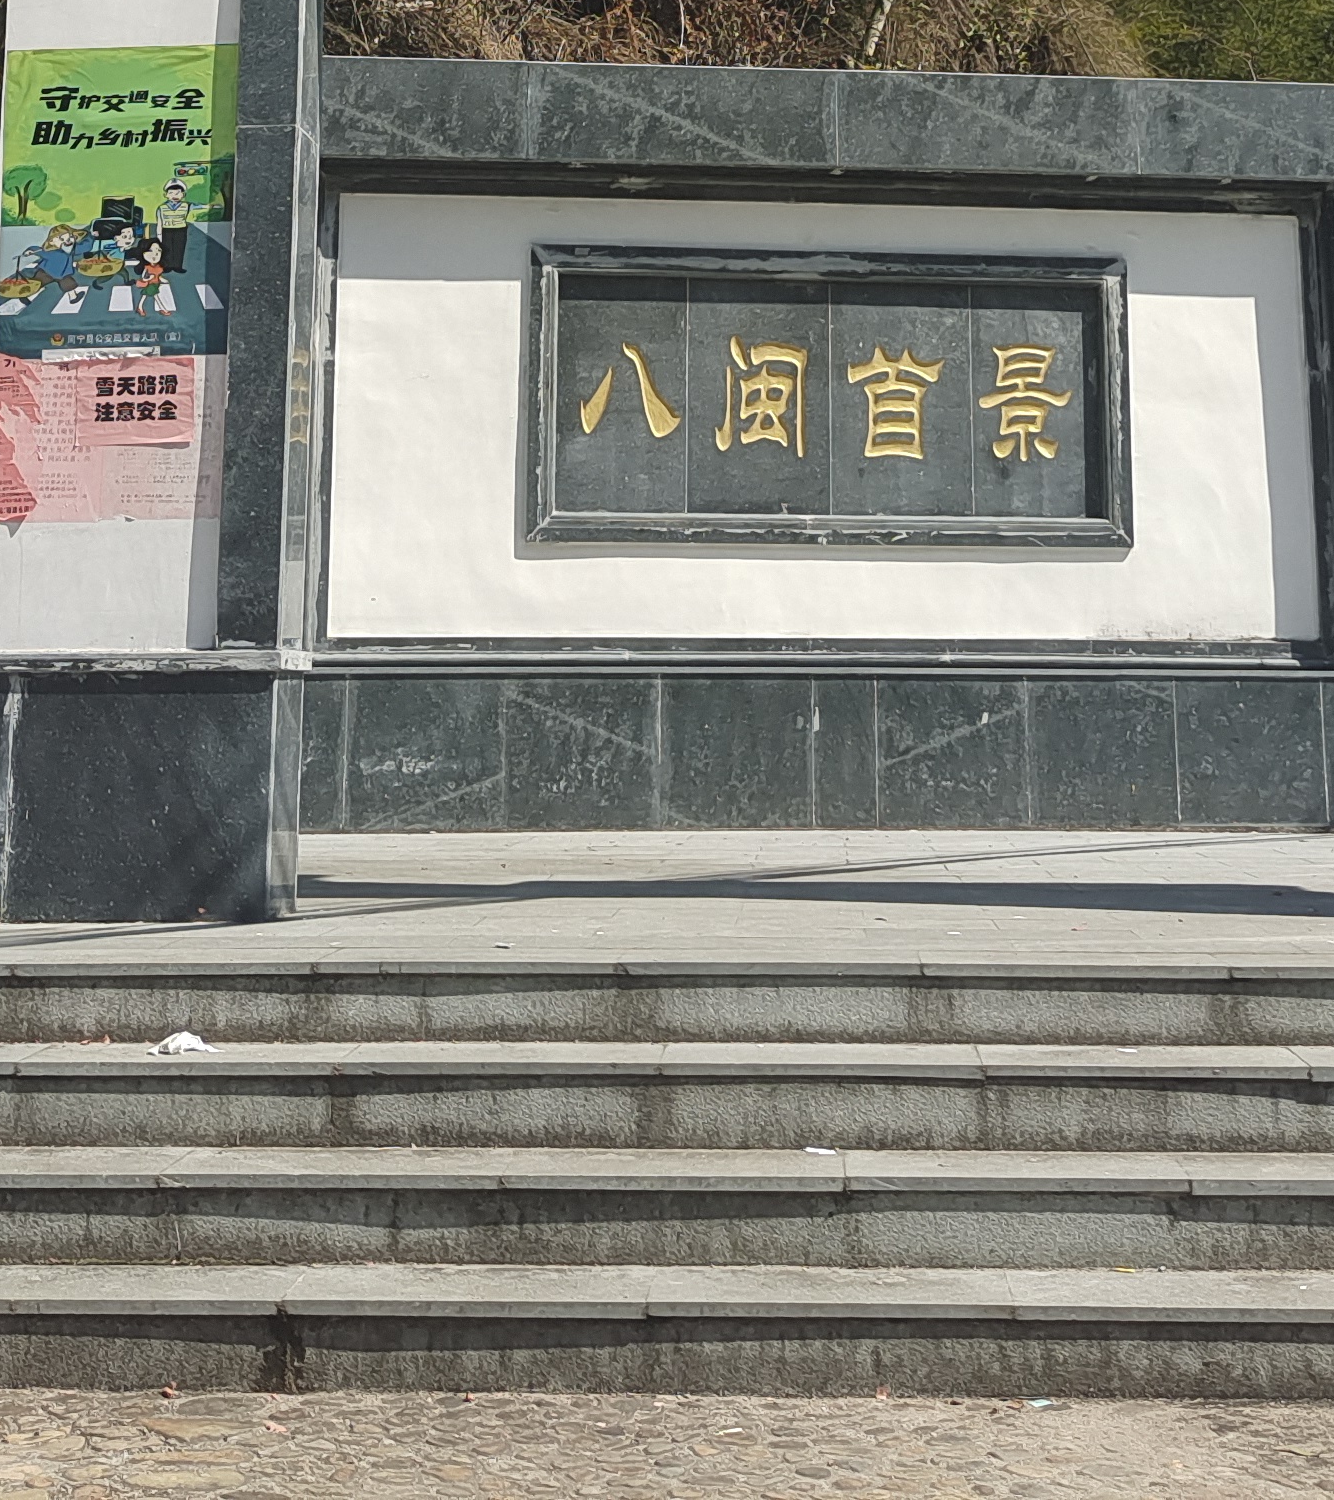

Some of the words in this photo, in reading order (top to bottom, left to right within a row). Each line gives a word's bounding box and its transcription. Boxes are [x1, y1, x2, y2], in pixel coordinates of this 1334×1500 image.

[39, 86, 206, 113] 守护交通安全
[31, 118, 212, 150] 助力乡村振兴
[95, 374, 179, 397] 雪天路滑
[580, 336, 1073, 462] 八闽首景
[94, 400, 179, 422] 注意安全
